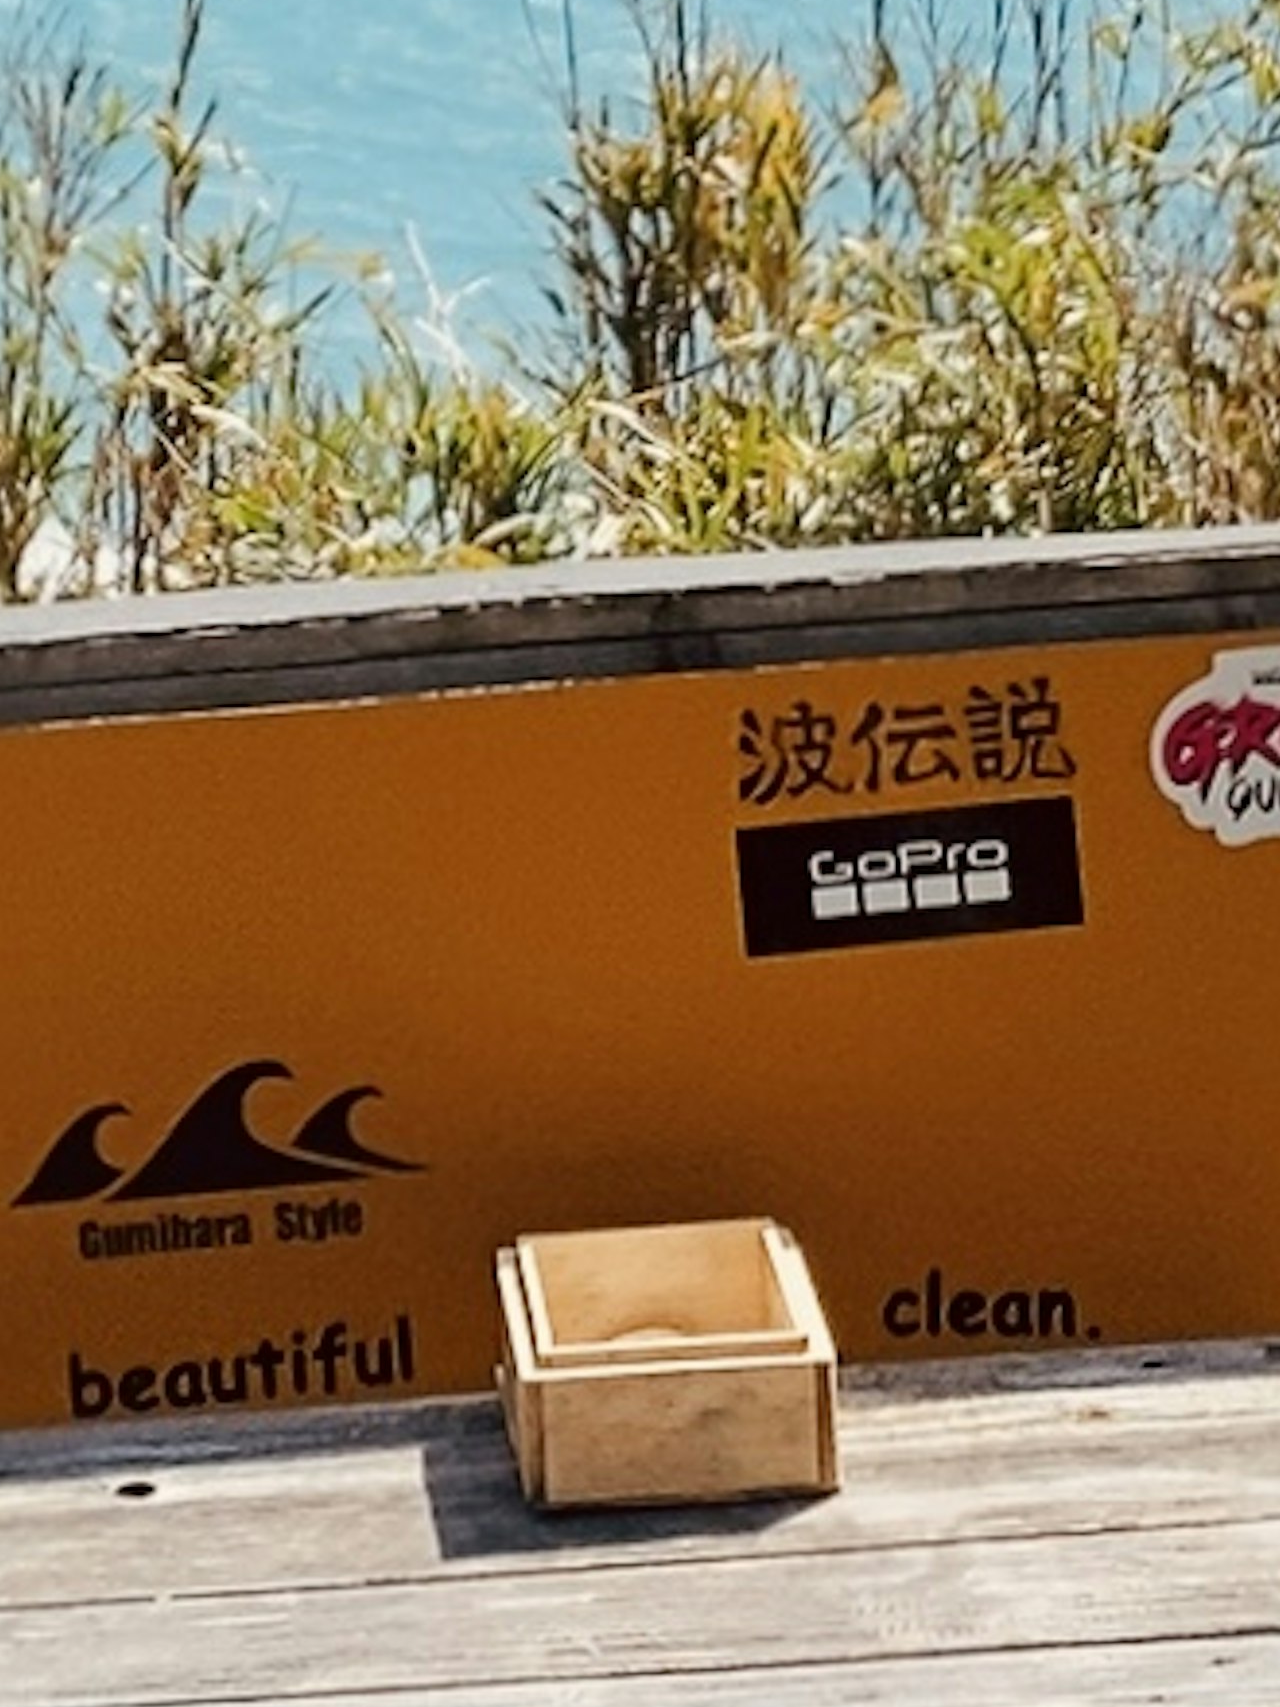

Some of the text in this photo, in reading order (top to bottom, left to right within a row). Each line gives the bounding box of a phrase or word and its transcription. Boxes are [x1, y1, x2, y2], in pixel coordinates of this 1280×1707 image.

[739, 675, 1078, 806] 波伝説
[808, 838, 1010, 885] GoPro
[79, 1198, 365, 1261] Gumihara Style
[69, 1314, 415, 1419] beautiful
[882, 1267, 1102, 1341] clean.
